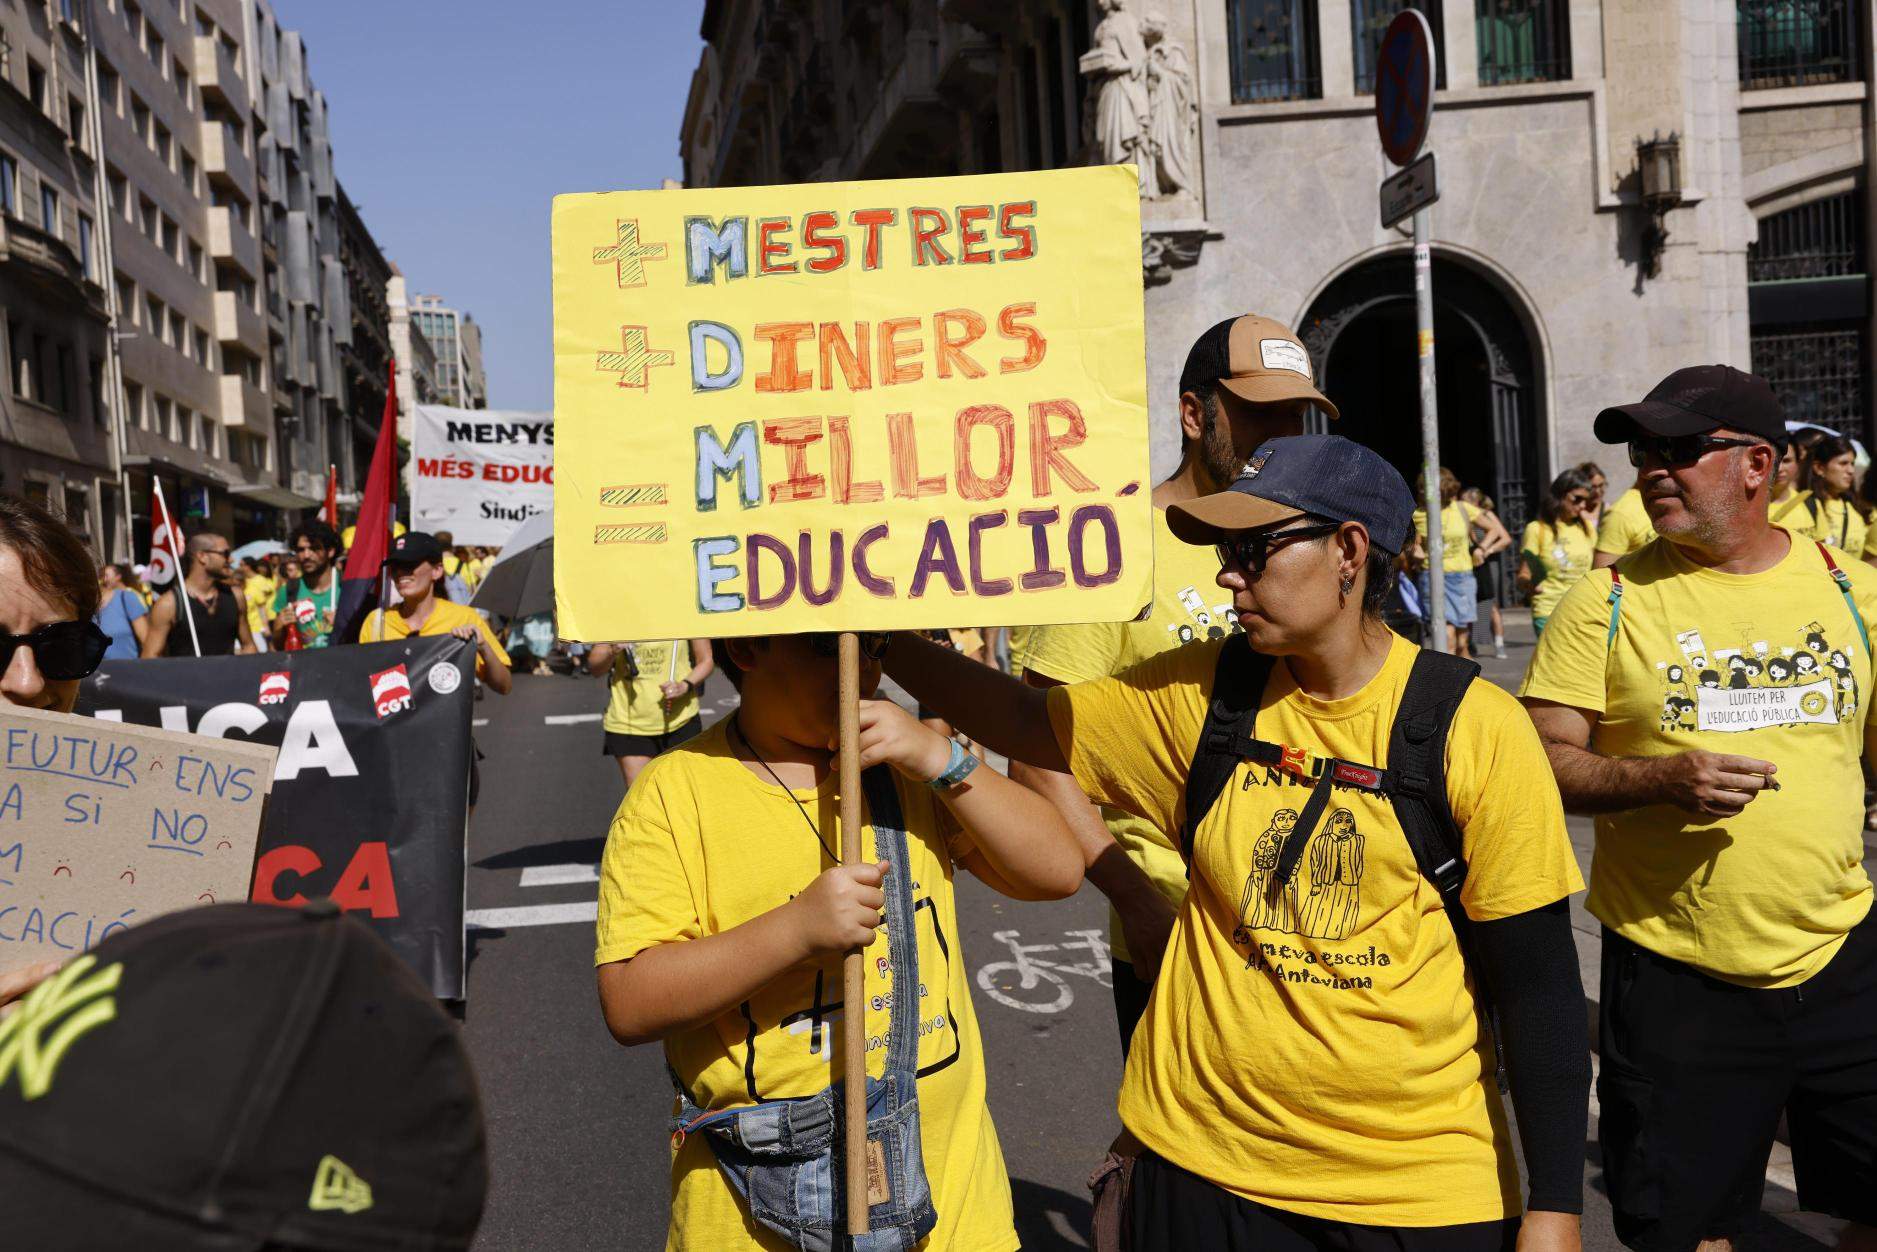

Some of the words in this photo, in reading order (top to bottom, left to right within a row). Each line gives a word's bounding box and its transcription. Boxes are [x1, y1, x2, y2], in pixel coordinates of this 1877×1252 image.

[684, 200, 1038, 286] MESTRES
[688, 302, 1047, 393] DINERS
[417, 453, 474, 479] MÉS
[694, 399, 1100, 511] MILLOR
[692, 480, 1139, 614] EDUCACIÓ
[259, 693, 287, 705] CGT
[377, 695, 411, 717] CGT
[1729, 692, 1766, 706] LLUITEM
[1770, 691, 1786, 703] PER
[1707, 708, 1758, 724] L'EDUCACIÓ
[1762, 707, 1800, 721] PÚBLICA
[8, 729, 138, 784] FUTUR
[176, 755, 256, 802] ENS
[152, 807, 209, 845] NO
[1259, 942, 1317, 964] meva
[1321, 946, 1391, 967] escola
[1275, 963, 1373, 990] Antaviana
